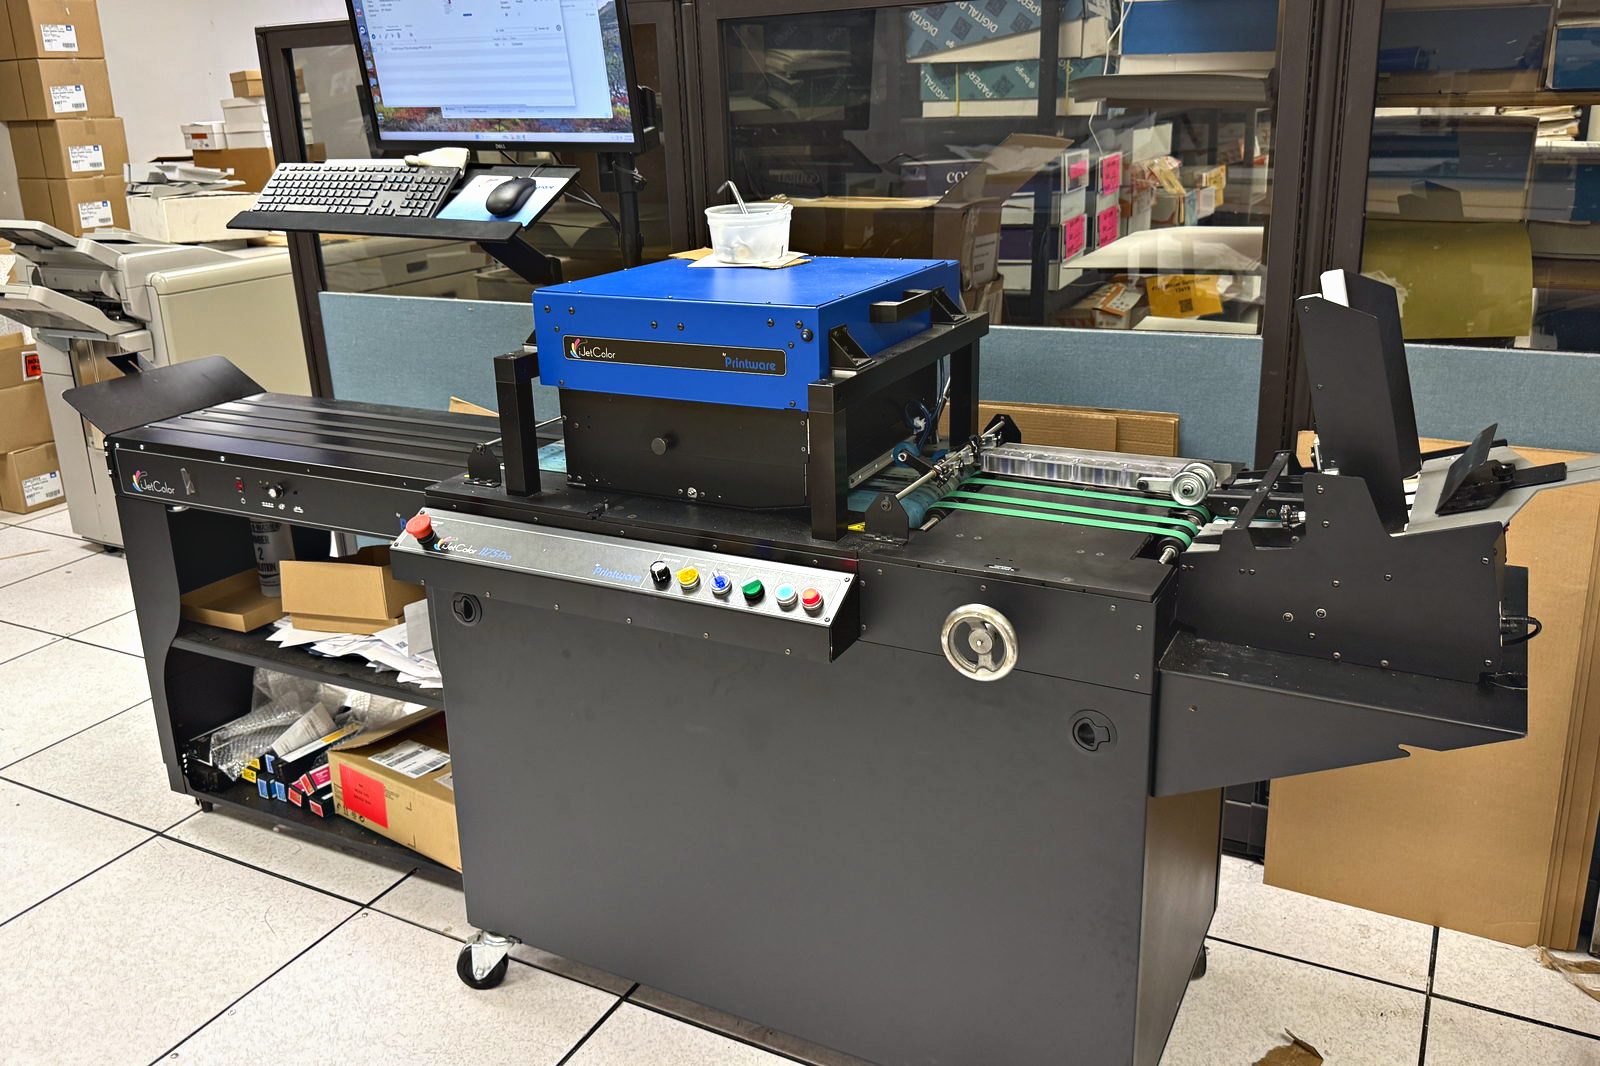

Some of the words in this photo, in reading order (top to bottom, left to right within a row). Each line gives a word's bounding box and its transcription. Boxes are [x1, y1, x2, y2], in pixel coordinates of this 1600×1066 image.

[968, 4, 998, 33] DIGITAL
[578, 346, 616, 359] iJetColor
[725, 356, 776, 371] Printware
[257, 546, 265, 561] 2
